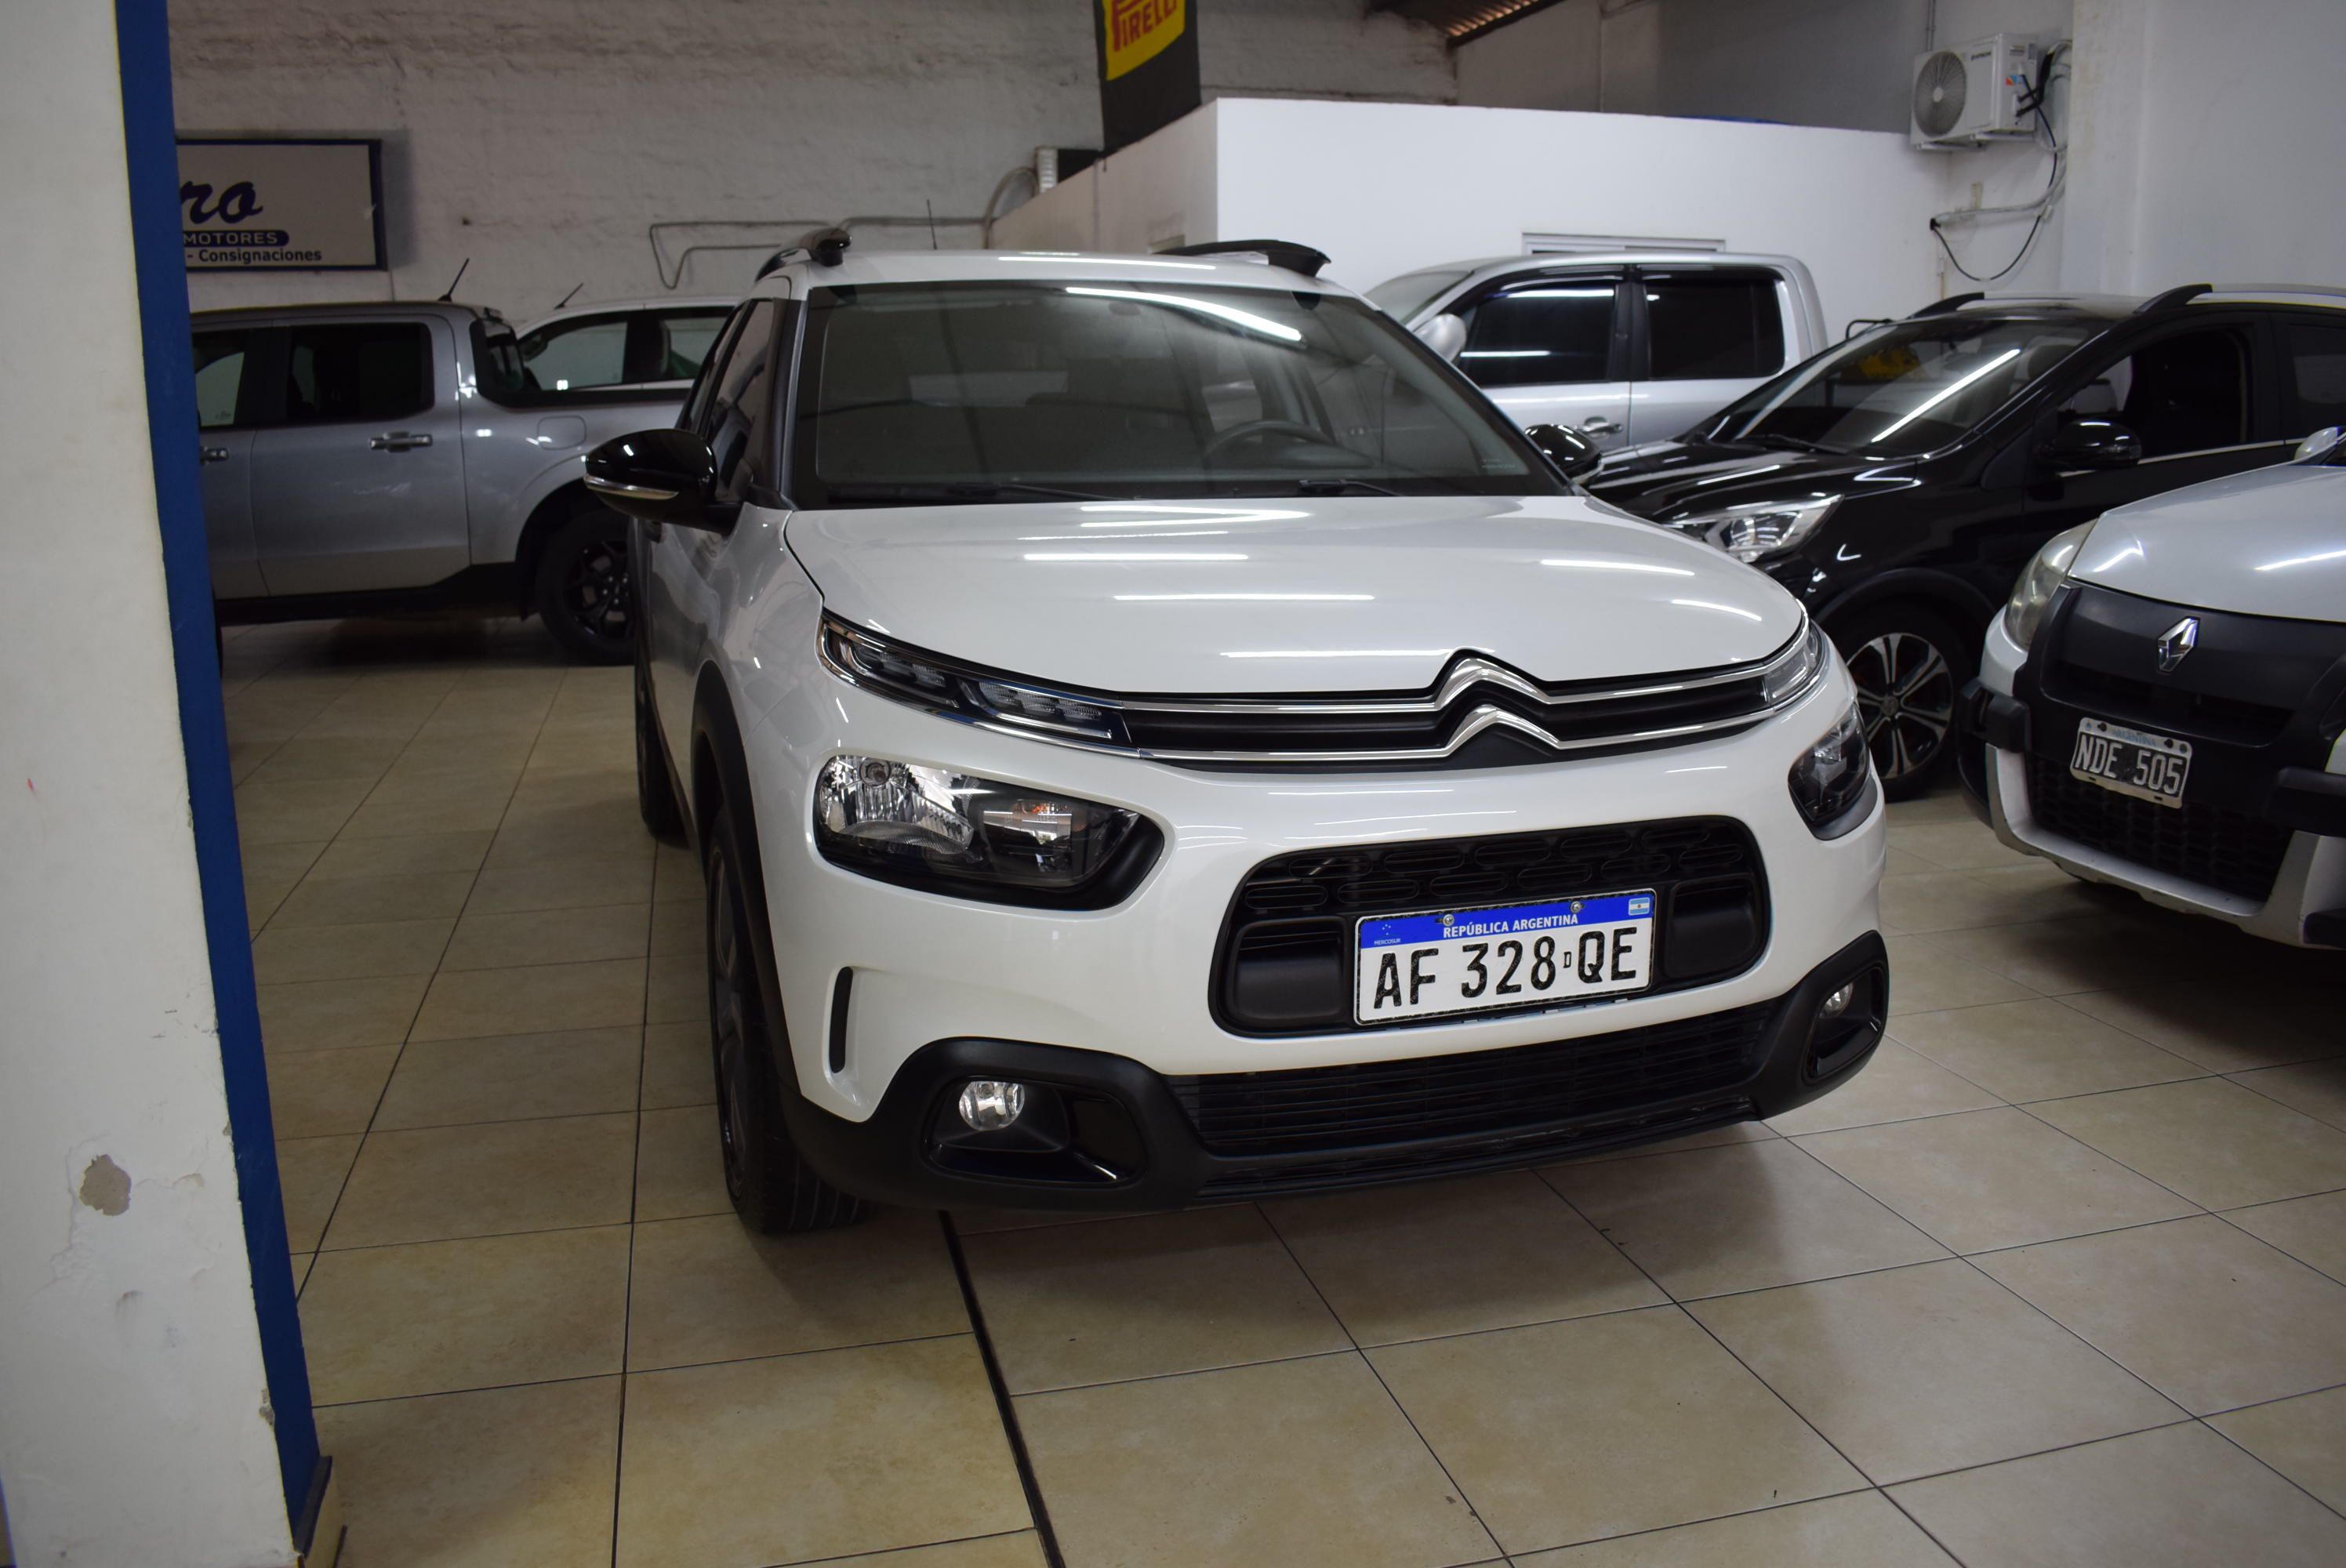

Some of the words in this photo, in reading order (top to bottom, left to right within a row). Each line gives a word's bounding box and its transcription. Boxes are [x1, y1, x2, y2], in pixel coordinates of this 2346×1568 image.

[183, 232, 278, 245] MOTORES
[199, 248, 322, 265] Consignaciones
[2074, 734, 2123, 779] NDE
[2133, 749, 2183, 795] 505
[1443, 921, 1509, 938] REPÚBLICA
[1513, 914, 1578, 931] ARGENTINA
[1373, 947, 1440, 1010] AF
[1461, 935, 1556, 999] 328
[1578, 926, 1638, 984] QE
